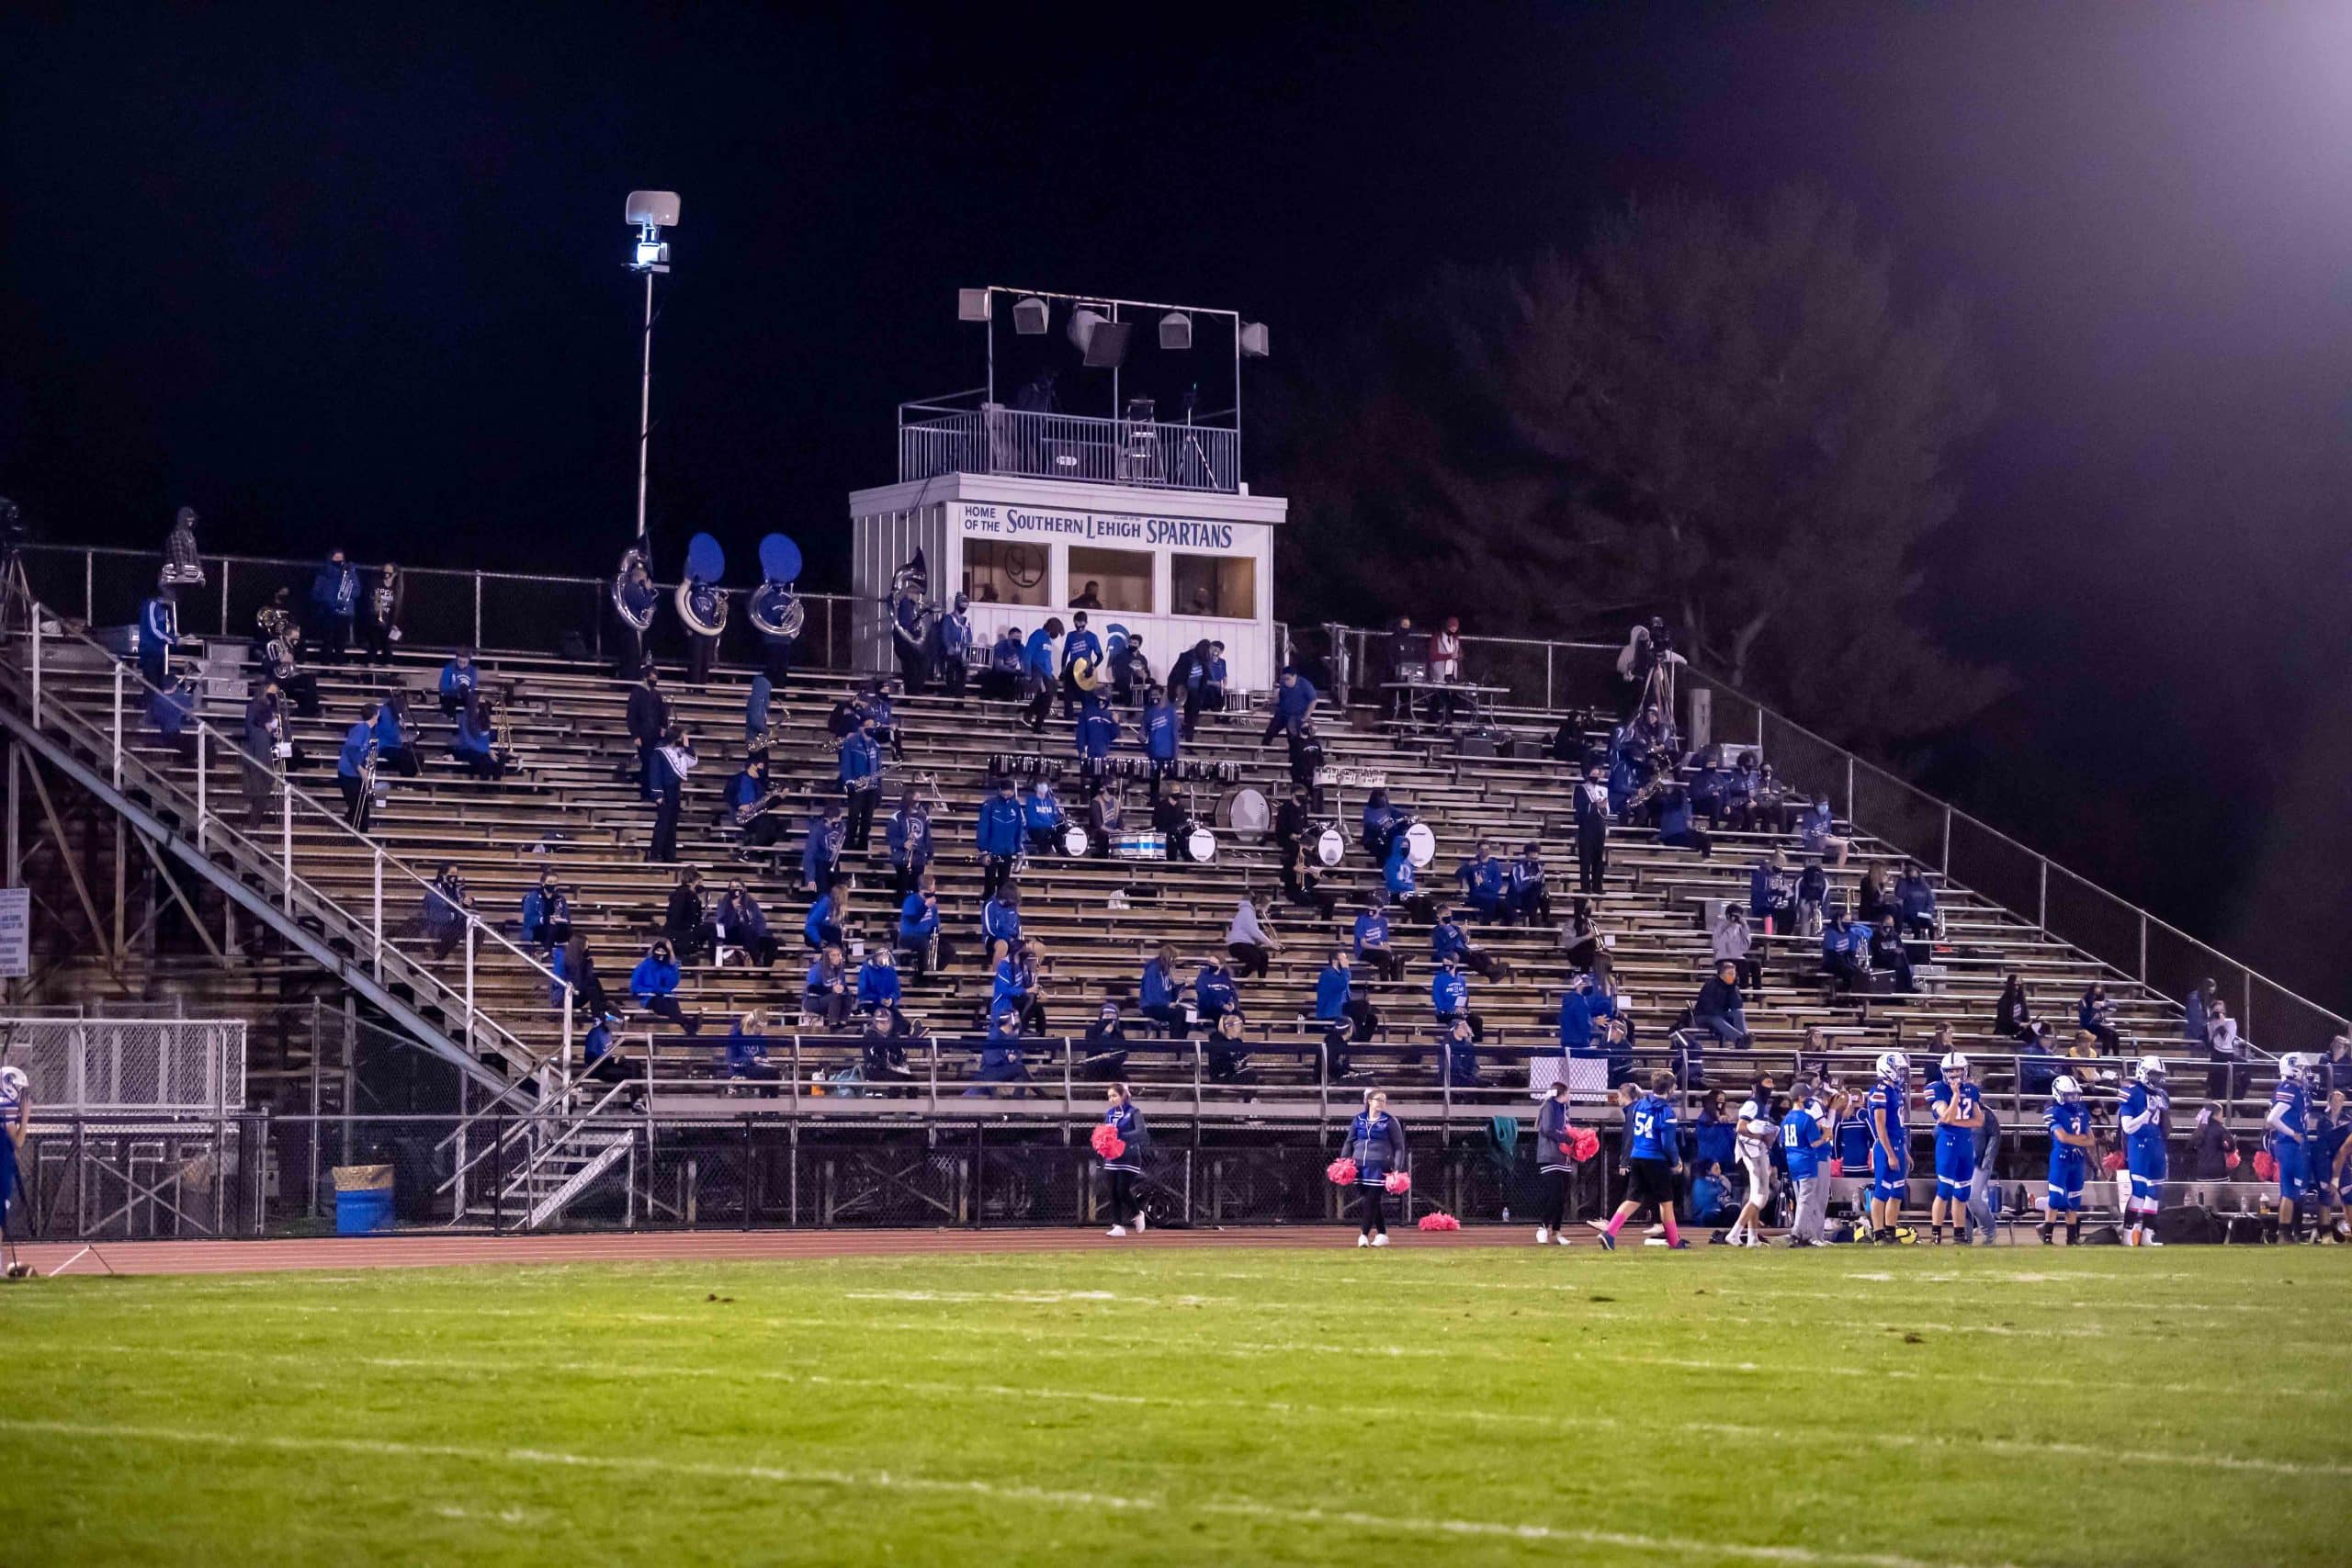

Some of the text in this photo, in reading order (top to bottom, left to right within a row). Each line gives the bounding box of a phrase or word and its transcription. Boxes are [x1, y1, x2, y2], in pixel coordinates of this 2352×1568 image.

[965, 505, 996, 518] HOME
[965, 519, 1001, 533] OF THE
[1006, 509, 1232, 548] SOUTHERN LEHIGH SPARTANS
[1634, 1111, 1654, 1139] 54
[1784, 1123, 1798, 1147] 18
